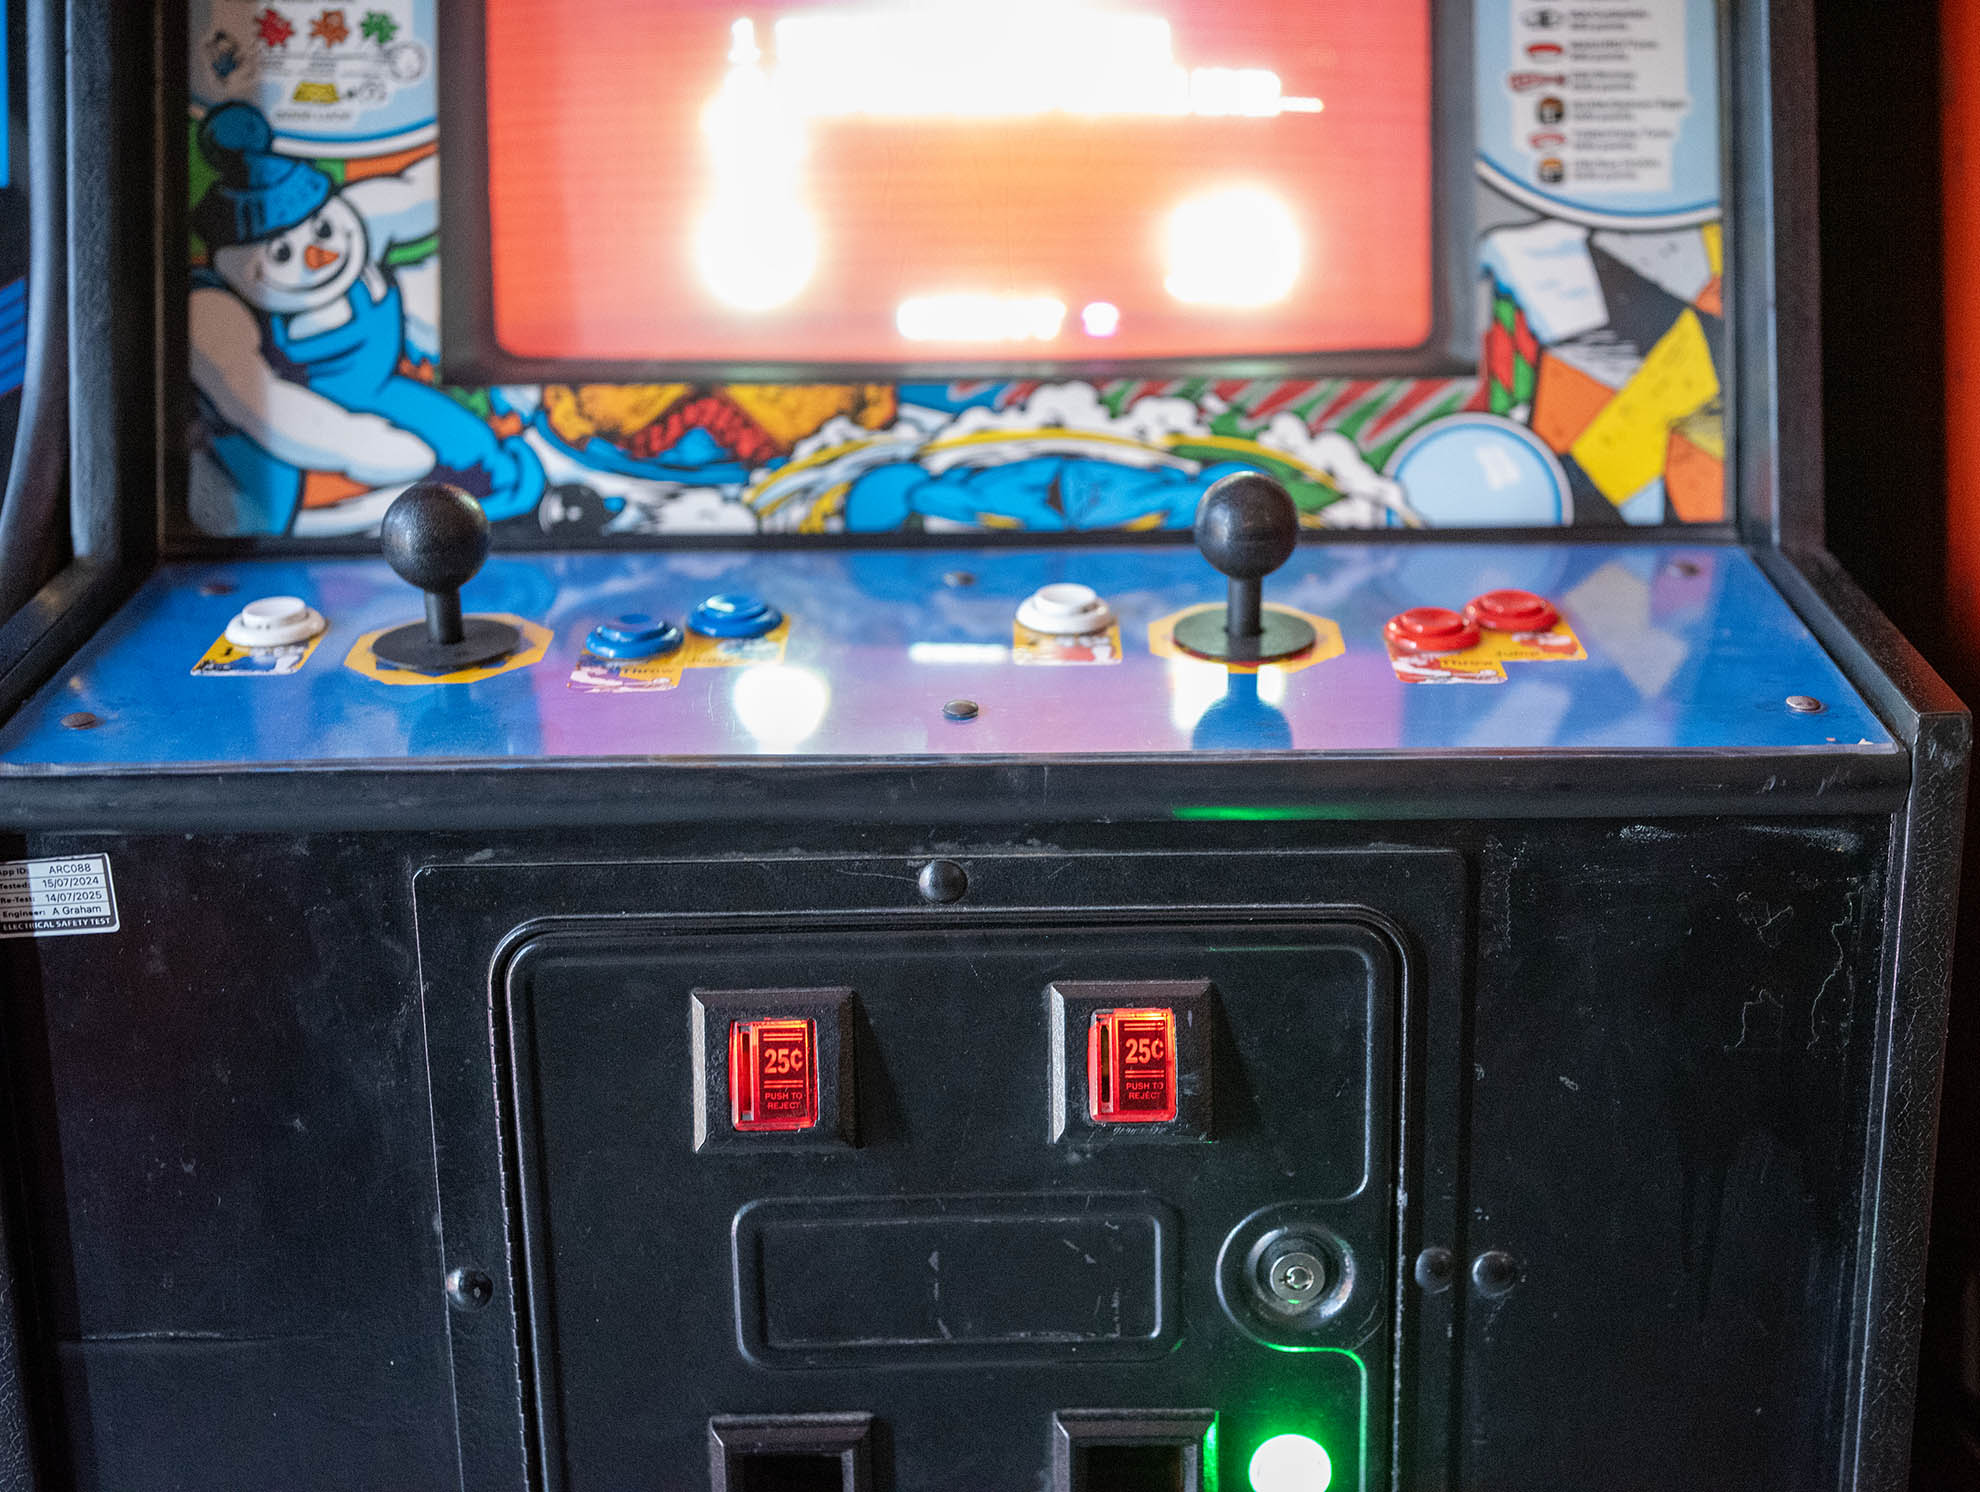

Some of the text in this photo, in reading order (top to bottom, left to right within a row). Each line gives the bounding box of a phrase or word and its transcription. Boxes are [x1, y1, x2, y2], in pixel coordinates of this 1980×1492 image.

[49, 863, 92, 874] ARC088
[42, 876, 99, 889] 15/07/2024
[45, 890, 102, 903] 14/07/2025
[3, 910, 46, 919] Engineer:
[52, 905, 102, 915] A Graham
[3, 917, 111, 931] ELECTRICAL SAFETY TEST
[1125, 1038, 1164, 1064] 25¢
[763, 1048, 803, 1074] 25¢
[1126, 1082, 1164, 1091] PUSH TO
[765, 1091, 803, 1101] PUSH TO
[1128, 1092, 1161, 1100] REJECT
[767, 1101, 801, 1110] REJECT
